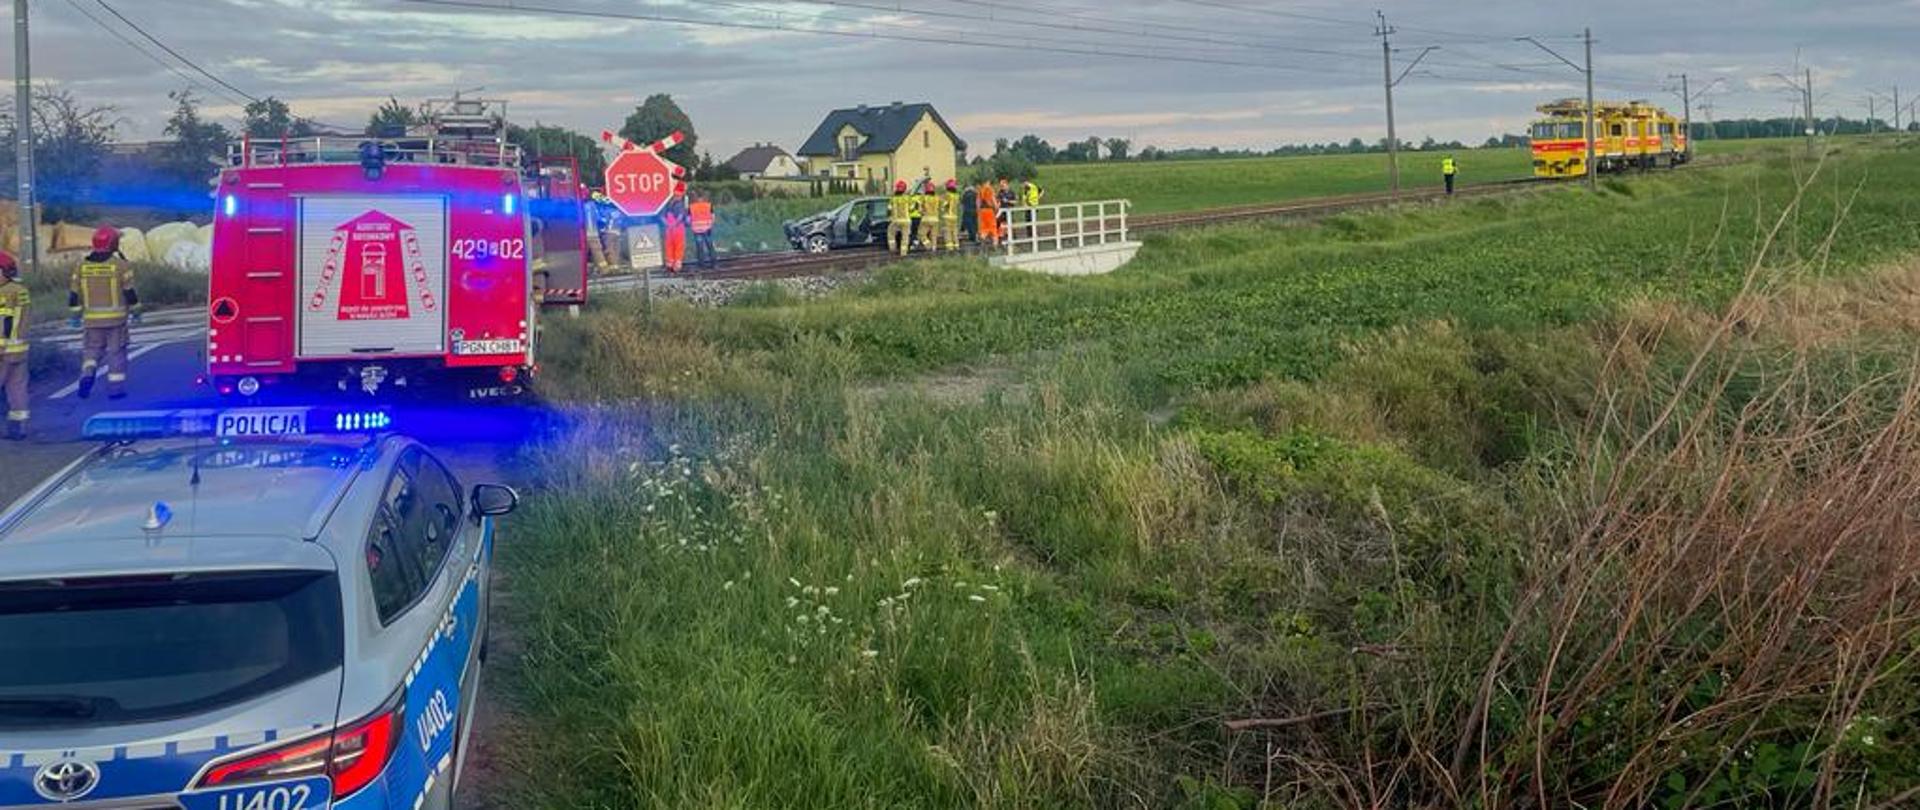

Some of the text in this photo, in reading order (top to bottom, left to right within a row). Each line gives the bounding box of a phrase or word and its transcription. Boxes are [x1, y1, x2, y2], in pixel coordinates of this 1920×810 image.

[614, 173, 665, 194] STOP
[222, 414, 301, 435] POLICJA
[417, 690, 453, 752] U402
